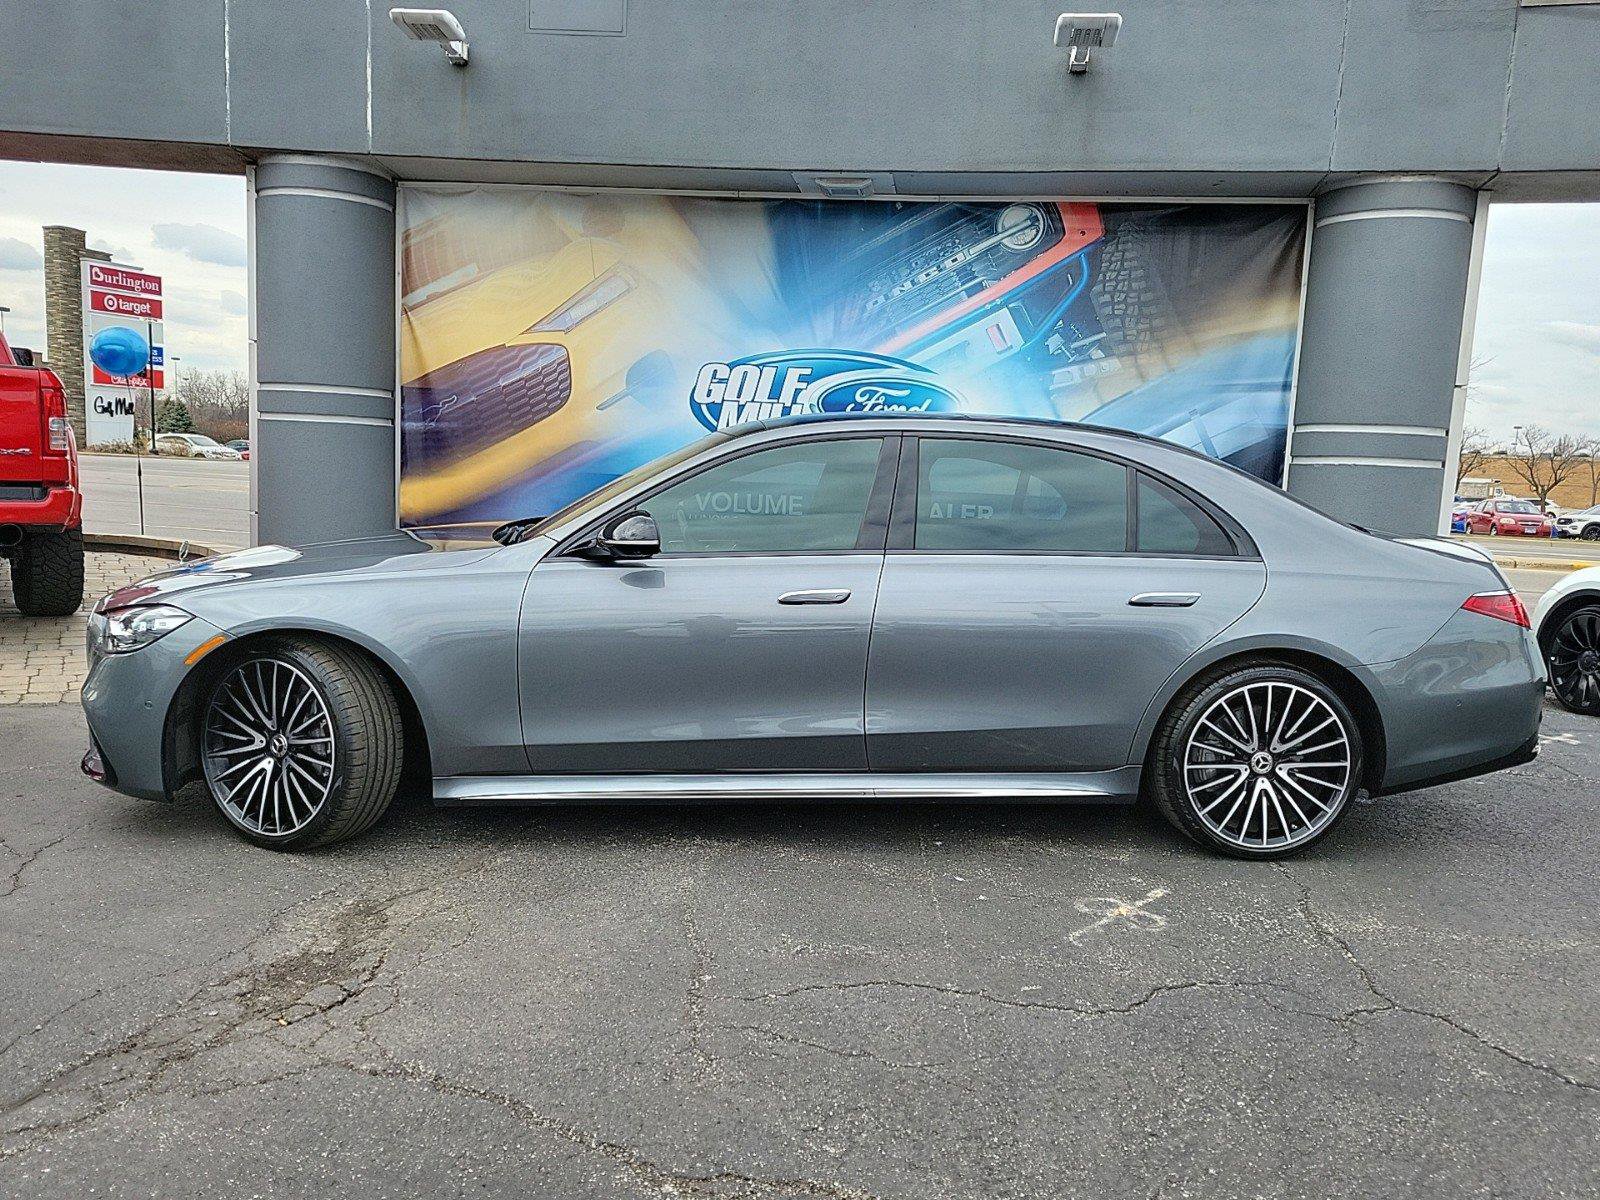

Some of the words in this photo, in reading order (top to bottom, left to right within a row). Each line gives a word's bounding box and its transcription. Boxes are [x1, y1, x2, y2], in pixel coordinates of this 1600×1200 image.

[92, 266, 160, 292] Burlington
[118, 298, 151, 314] target
[693, 362, 813, 408] GOLF
[694, 491, 804, 516] VOLUME
